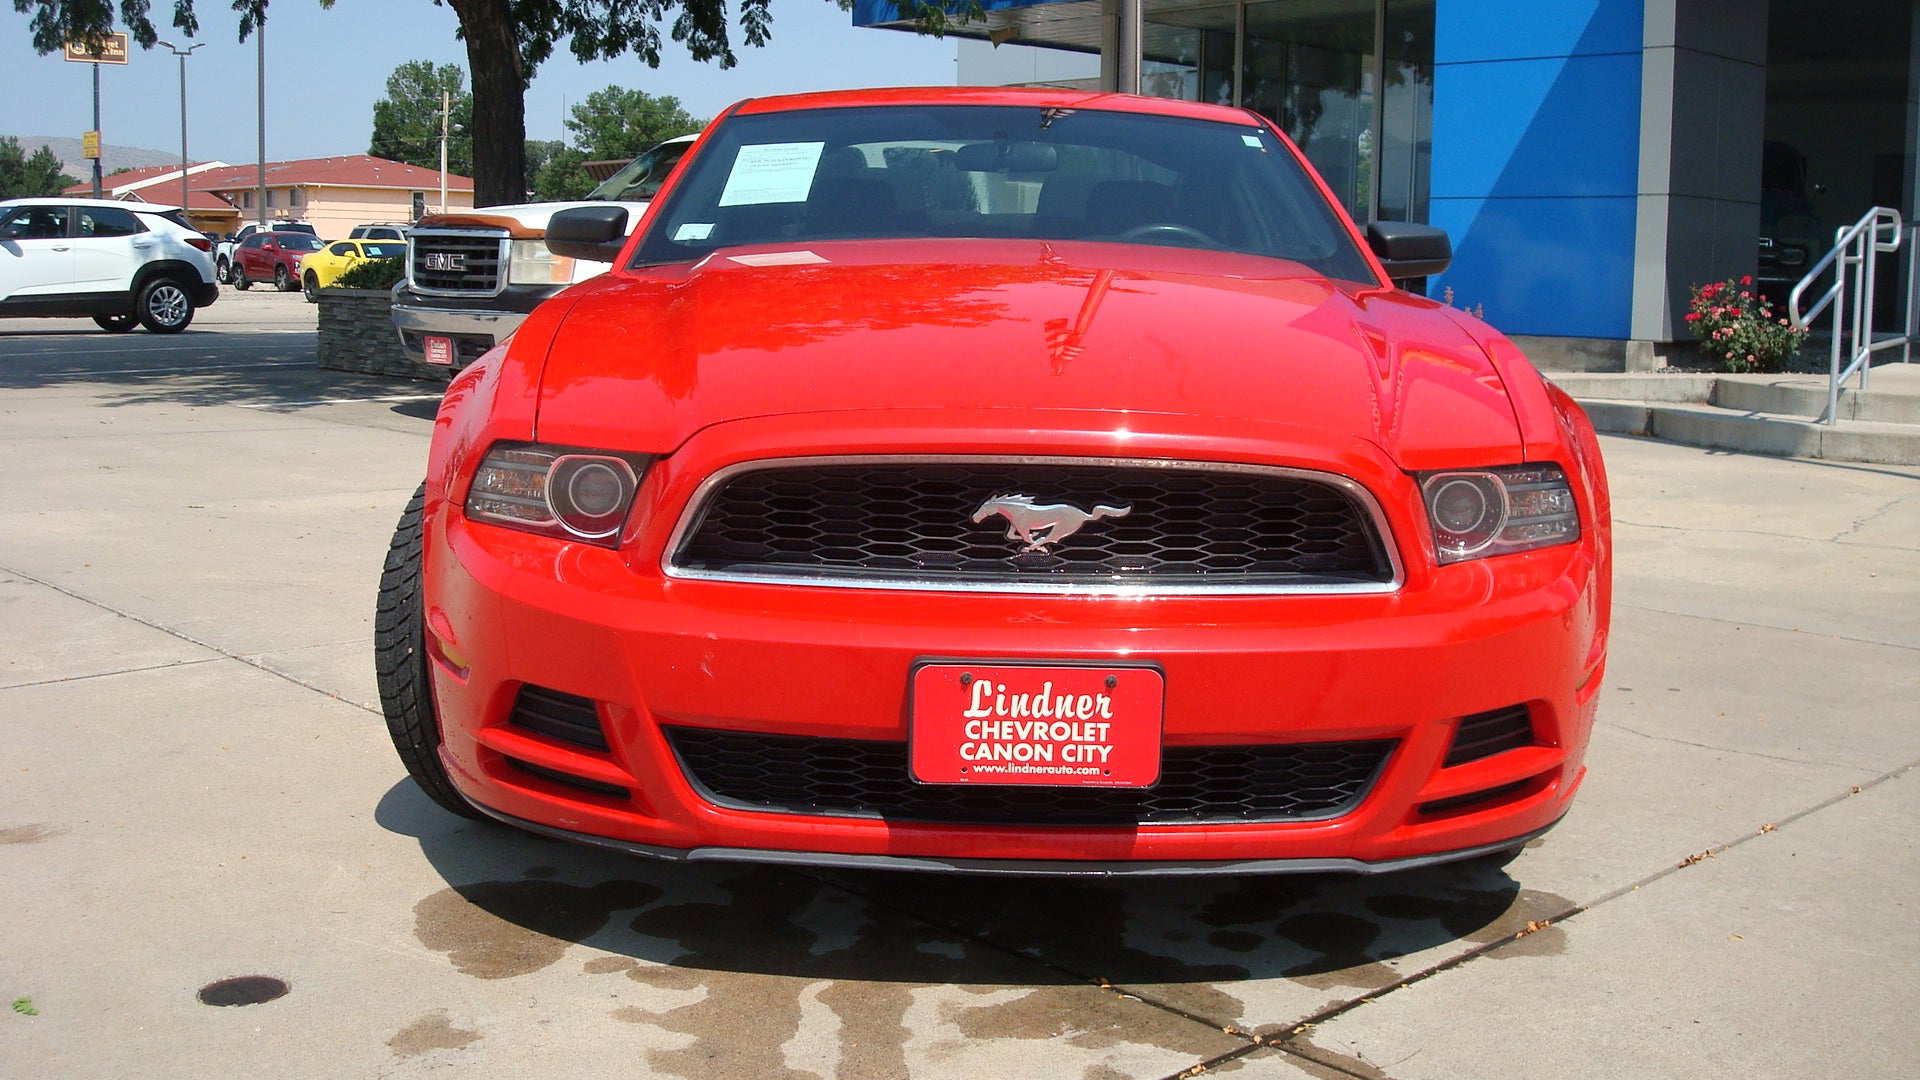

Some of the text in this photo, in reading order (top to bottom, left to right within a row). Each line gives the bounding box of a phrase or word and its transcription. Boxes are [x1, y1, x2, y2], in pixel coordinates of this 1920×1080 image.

[425, 253, 464, 271] GMC
[963, 679, 1113, 720] Lindner
[964, 720, 1111, 742] CHEVROLET
[959, 742, 1114, 763] CANON CITY
[973, 763, 1100, 776] www.lindnerauto.com
